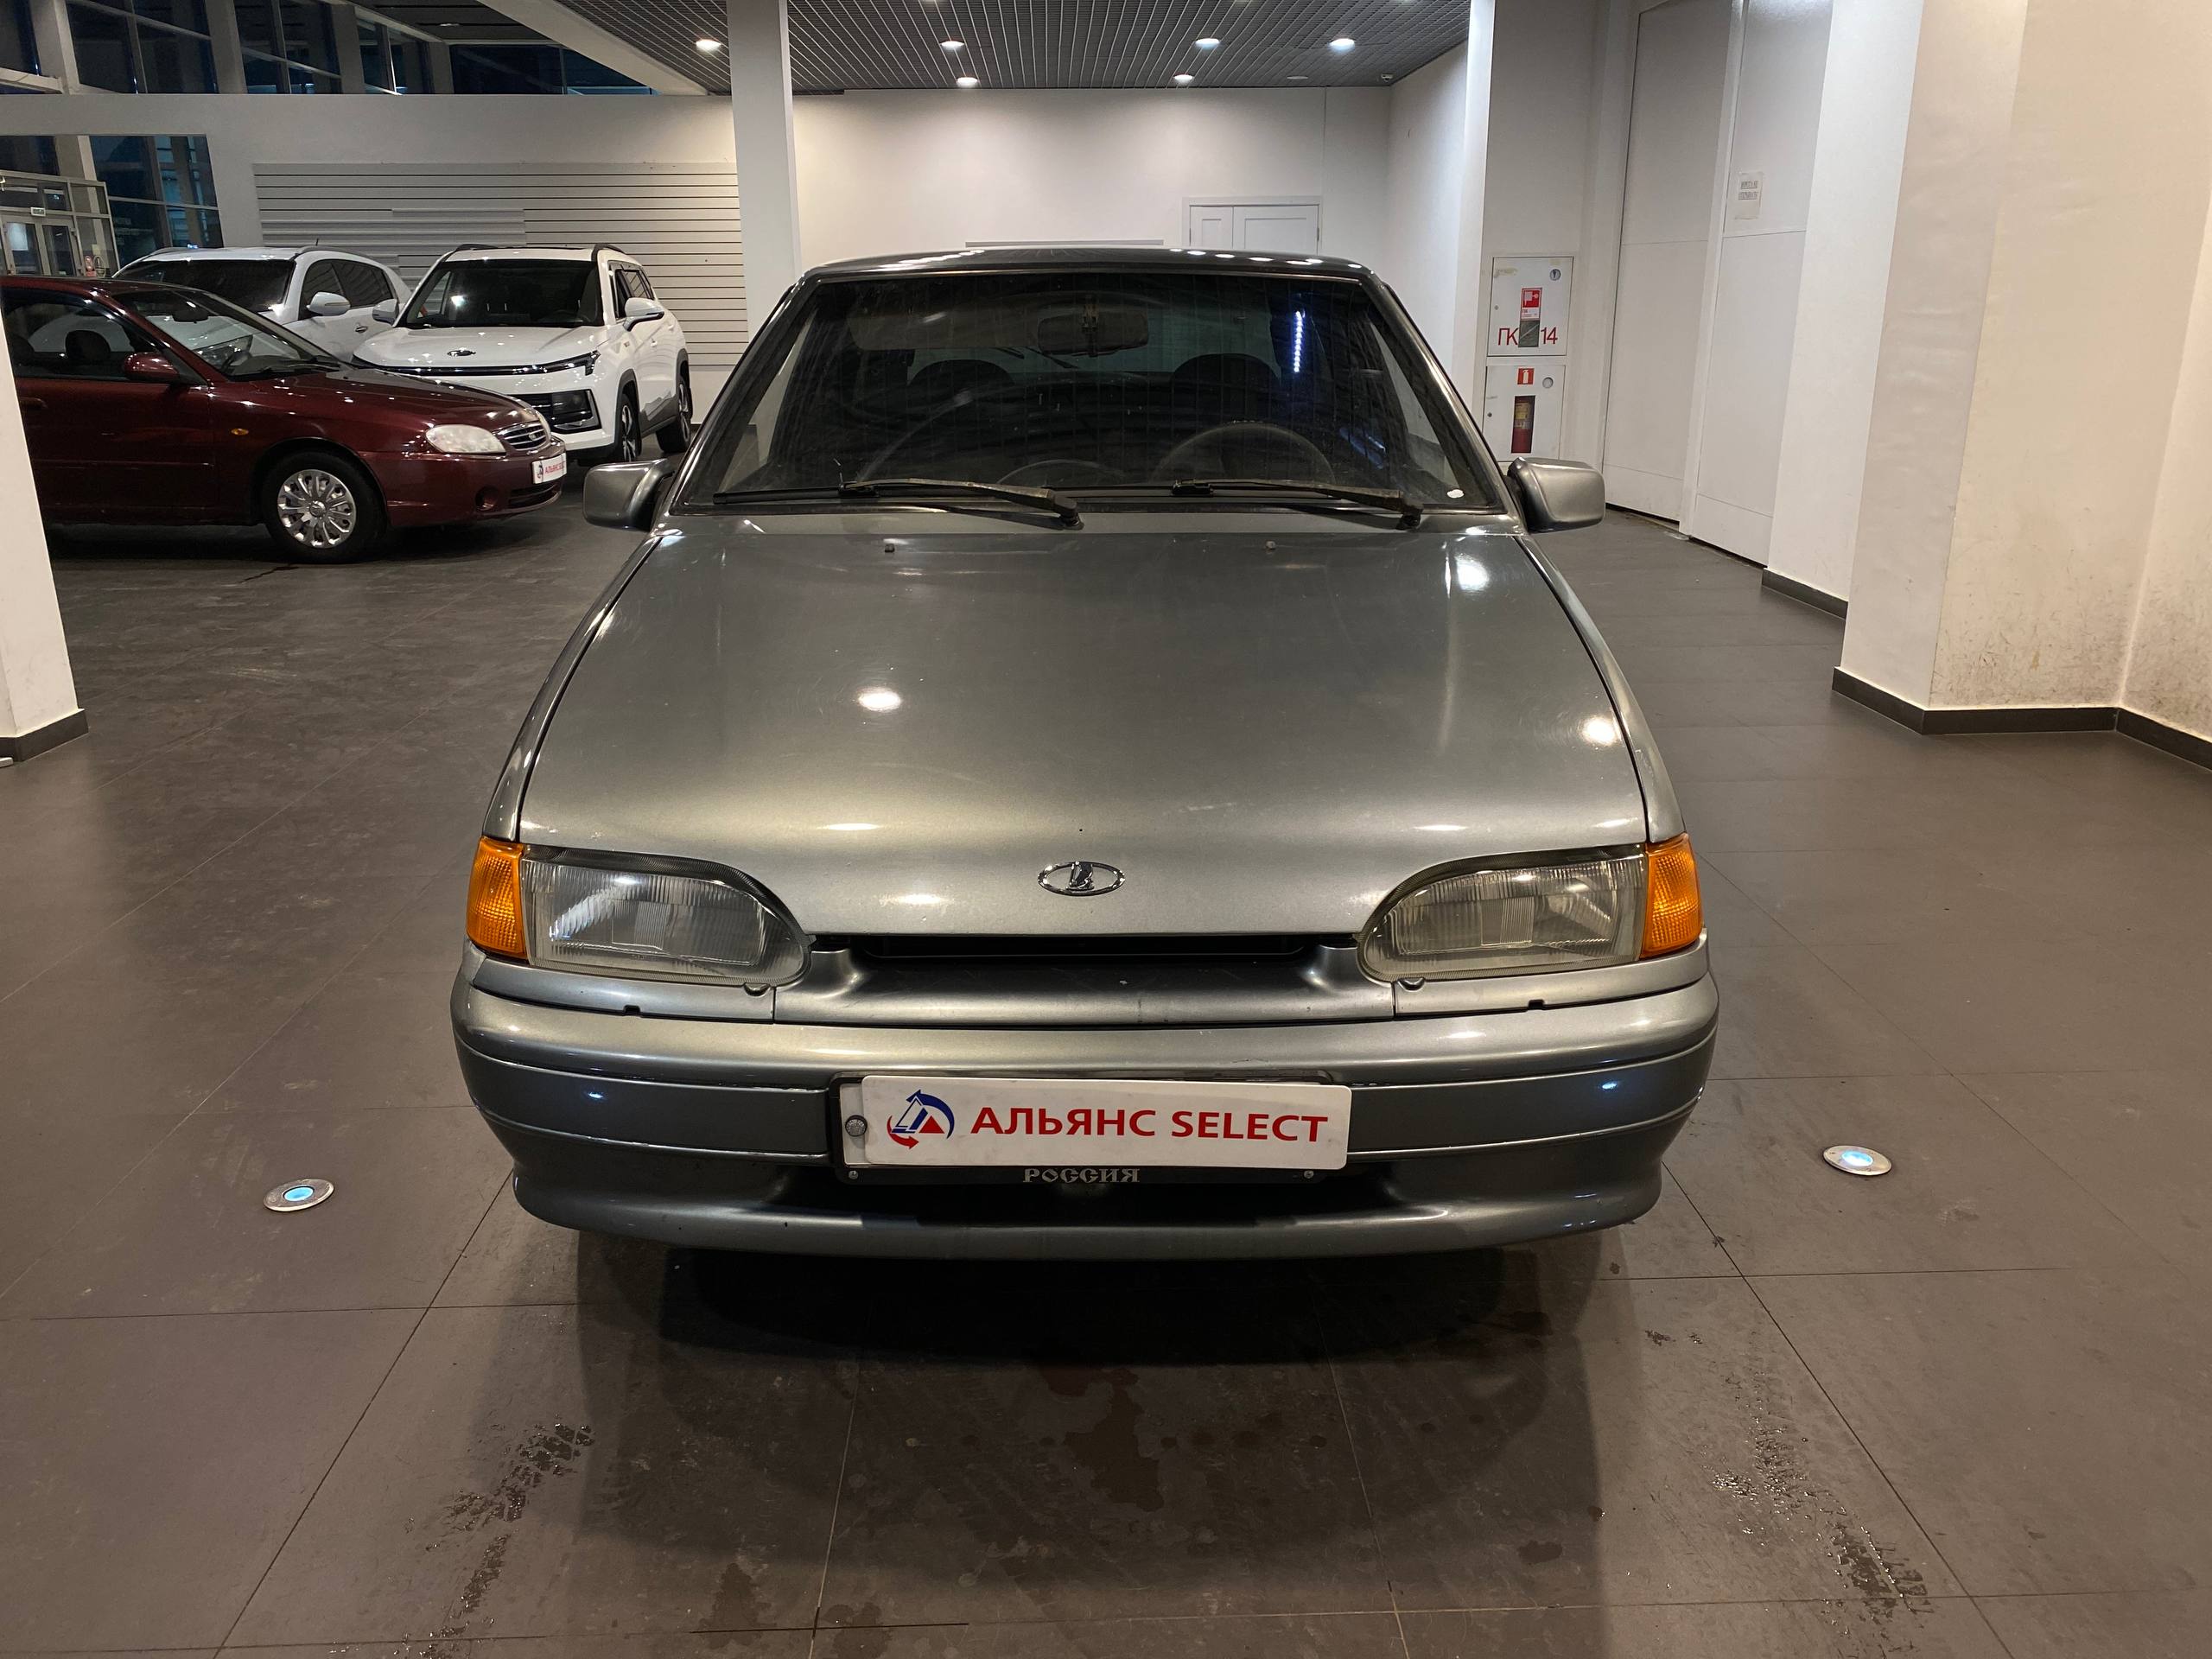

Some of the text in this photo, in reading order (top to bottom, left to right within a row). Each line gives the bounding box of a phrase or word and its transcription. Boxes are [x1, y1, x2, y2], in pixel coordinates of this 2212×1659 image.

[1497, 327, 1558, 346] ПК 14
[970, 1107, 1328, 1142] АЛЬЯНС SELECT
[1023, 1168, 1140, 1183] РОССИЯ
